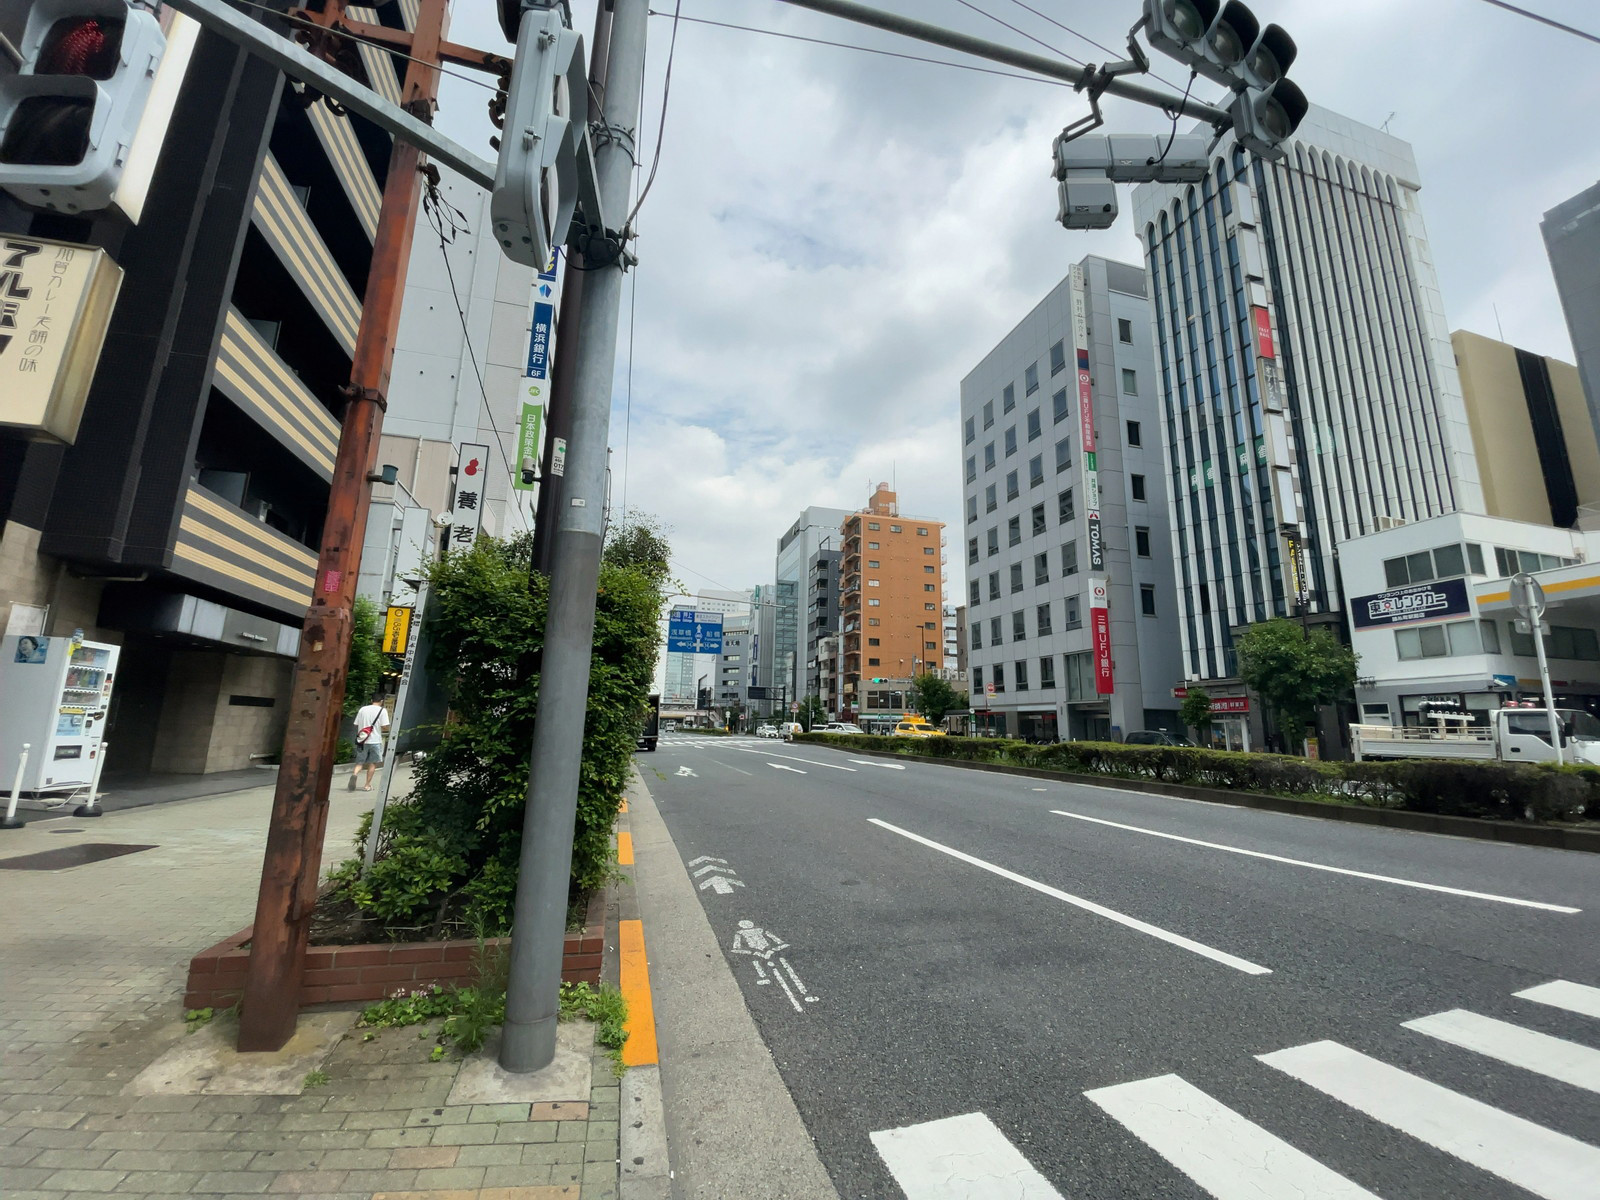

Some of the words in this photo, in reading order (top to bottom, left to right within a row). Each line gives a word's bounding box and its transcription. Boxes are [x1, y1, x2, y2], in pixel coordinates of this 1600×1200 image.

[532, 322, 546, 364] 横浜銀行
[531, 368, 541, 377] 6F
[523, 414, 536, 458] 日本政策金
[1090, 524, 1102, 565] TOMAS
[1369, 593, 1446, 614] 東京レンタカー
[401, 635, 417, 686] 日本中央競馬会
[1098, 615, 1110, 678] 三菱UFJ銀行
